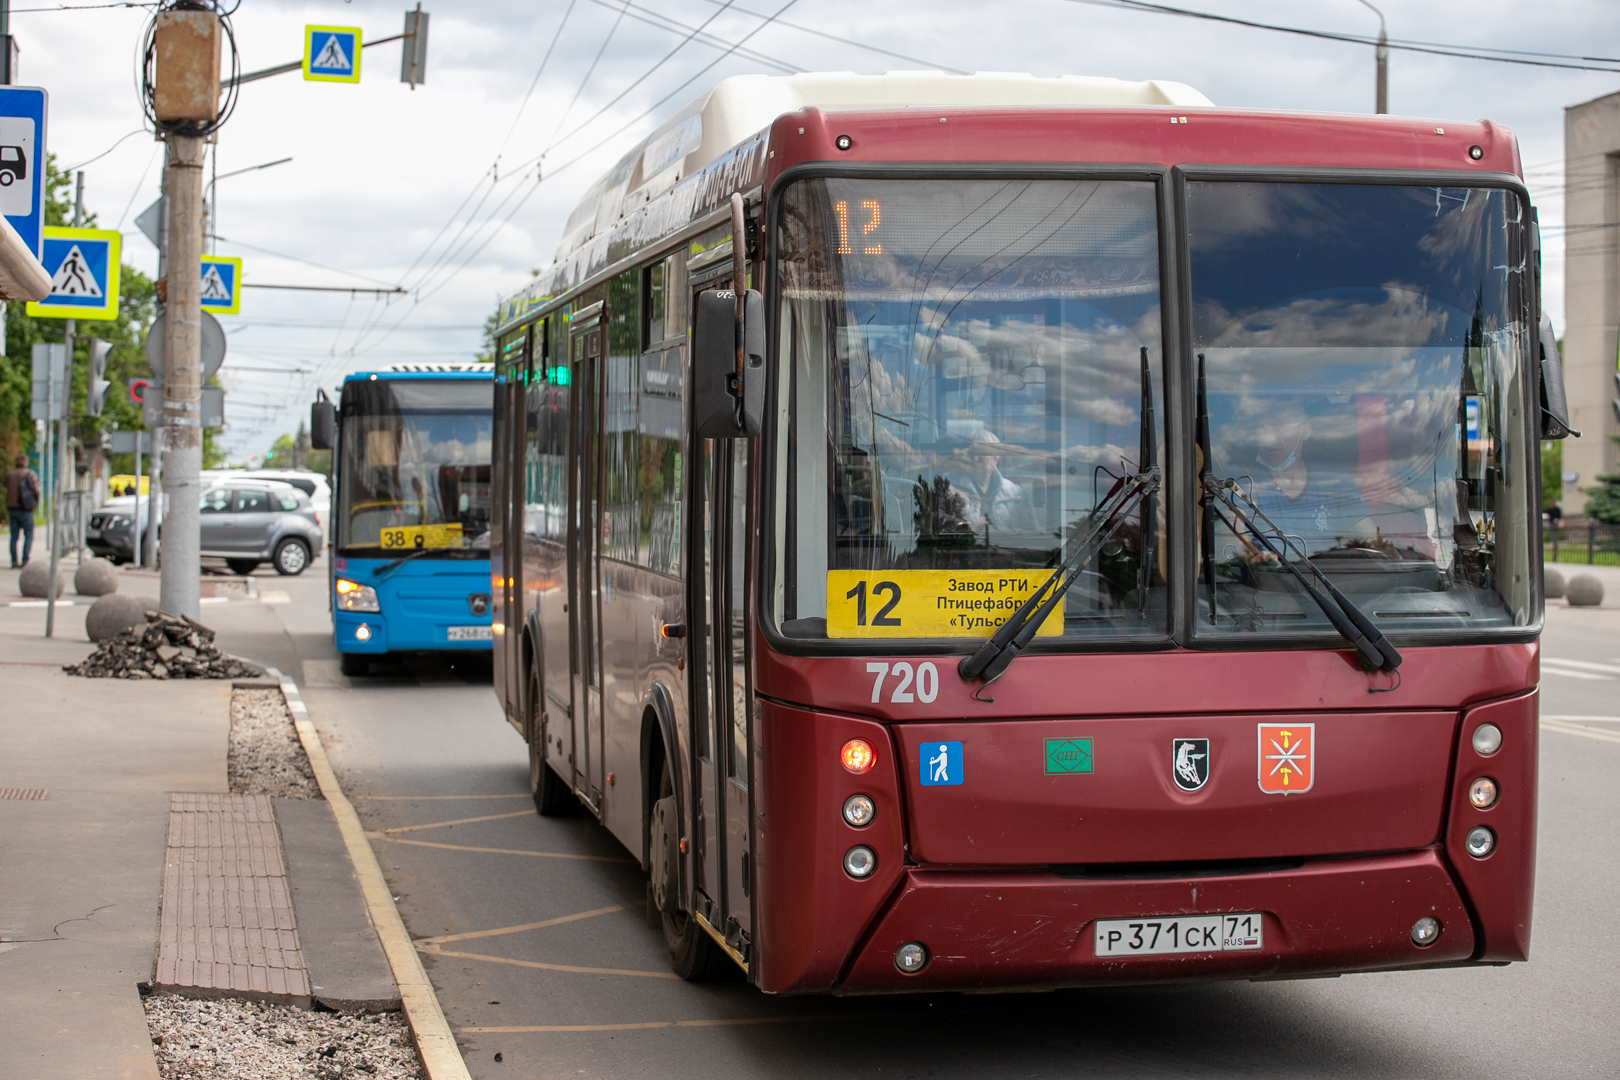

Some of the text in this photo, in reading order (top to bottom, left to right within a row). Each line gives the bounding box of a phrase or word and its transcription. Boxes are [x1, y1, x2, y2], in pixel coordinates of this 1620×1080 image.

[836, 201, 882, 254] 12
[384, 531, 405, 548] 38
[948, 578, 994, 594] Завод
[999, 579, 1028, 591] РТИ
[846, 581, 901, 626] 12
[950, 614, 1008, 630] «Тульс
[866, 661, 939, 703] 720
[1056, 751, 1081, 762] СПГ
[1226, 916, 1252, 938] 71
[1224, 938, 1243, 947] RUS
